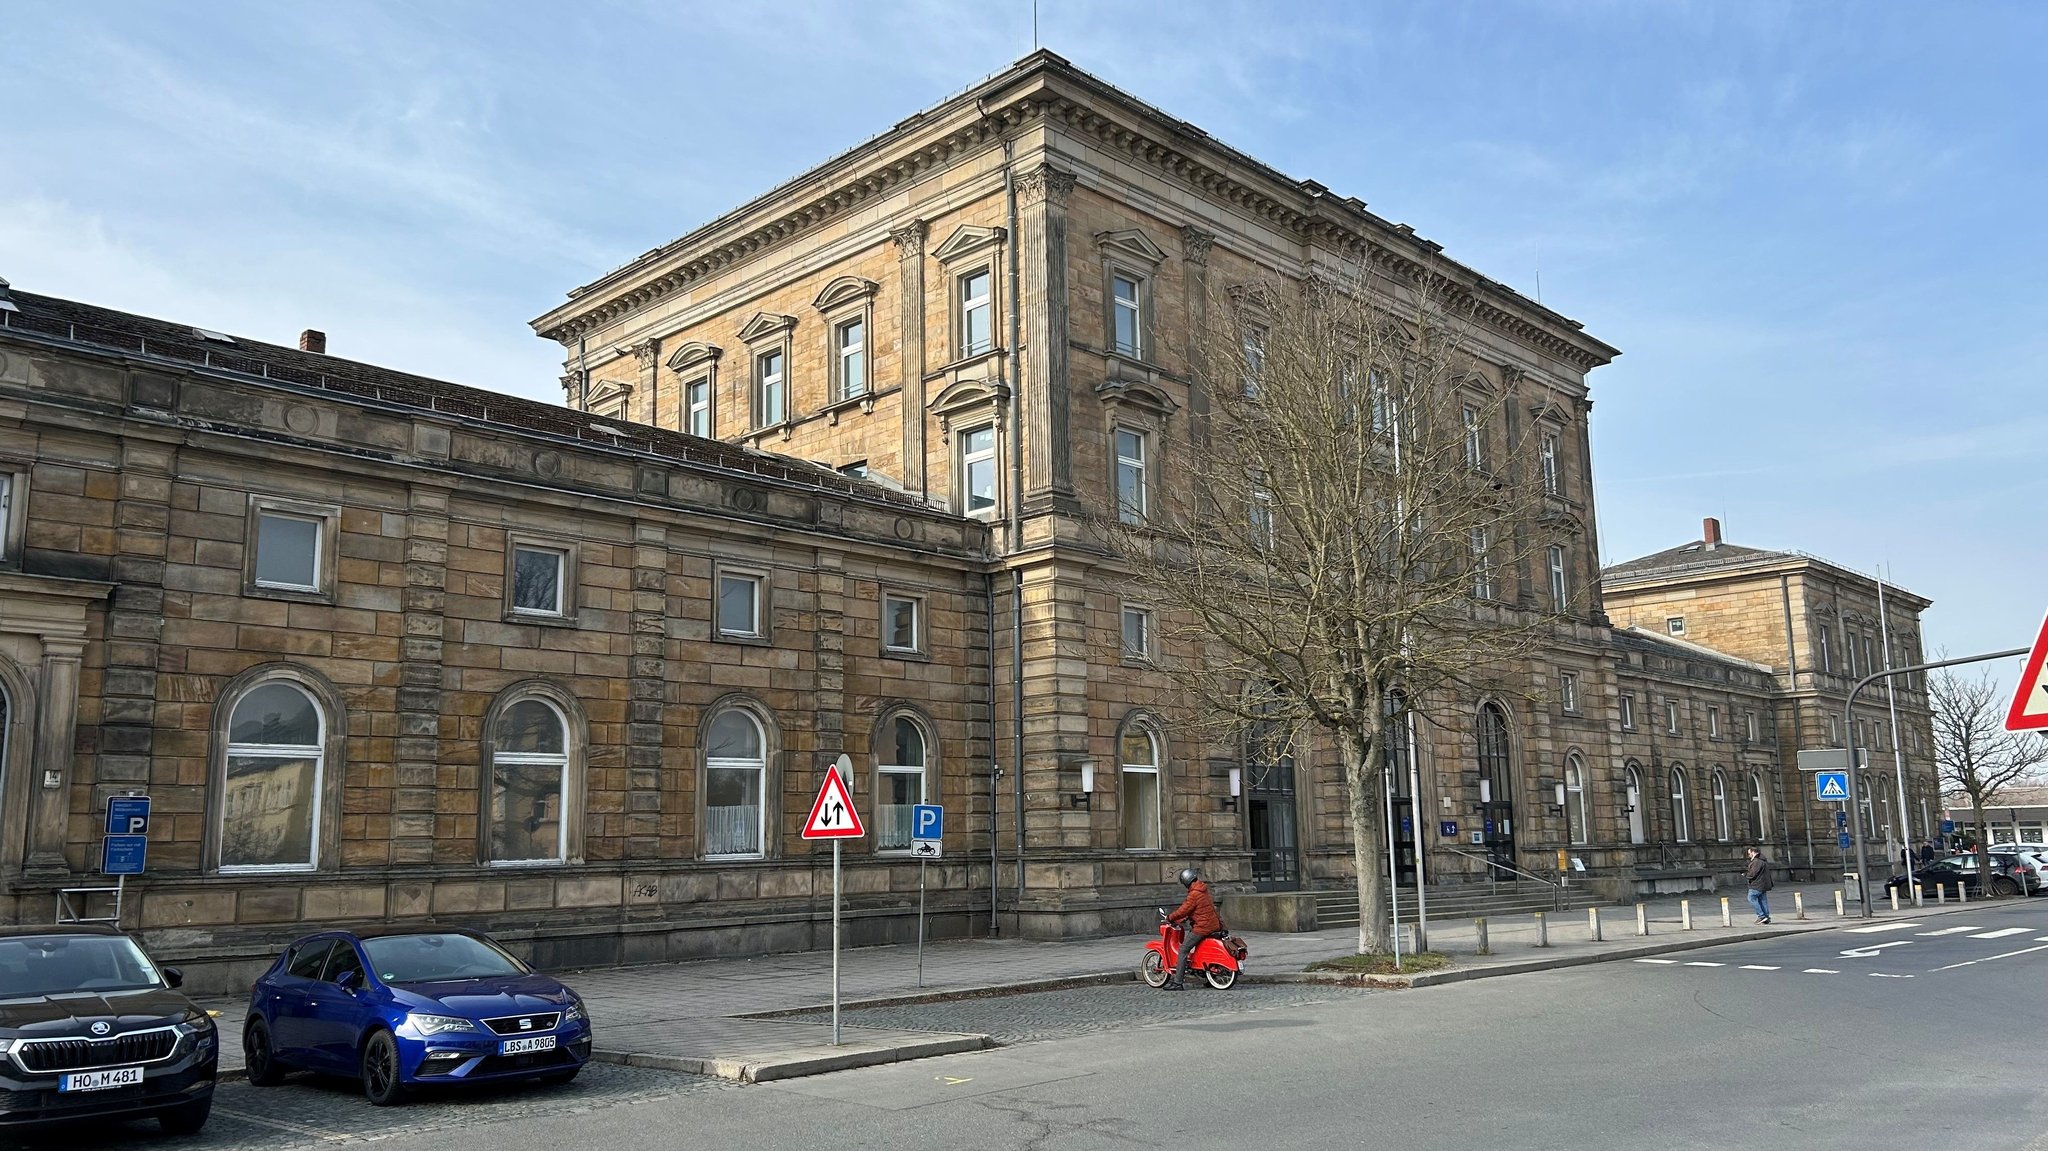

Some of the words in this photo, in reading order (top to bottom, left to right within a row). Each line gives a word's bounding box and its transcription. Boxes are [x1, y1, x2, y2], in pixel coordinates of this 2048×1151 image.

[129, 817, 145, 833] P
[920, 809, 936, 835] P
[504, 1041, 521, 1053] LBS
[528, 1040, 533, 1050] A
[535, 1037, 555, 1050] 9805
[73, 1074, 92, 1089] HO
[100, 1072, 110, 1085] M
[113, 1070, 138, 1083] 481
